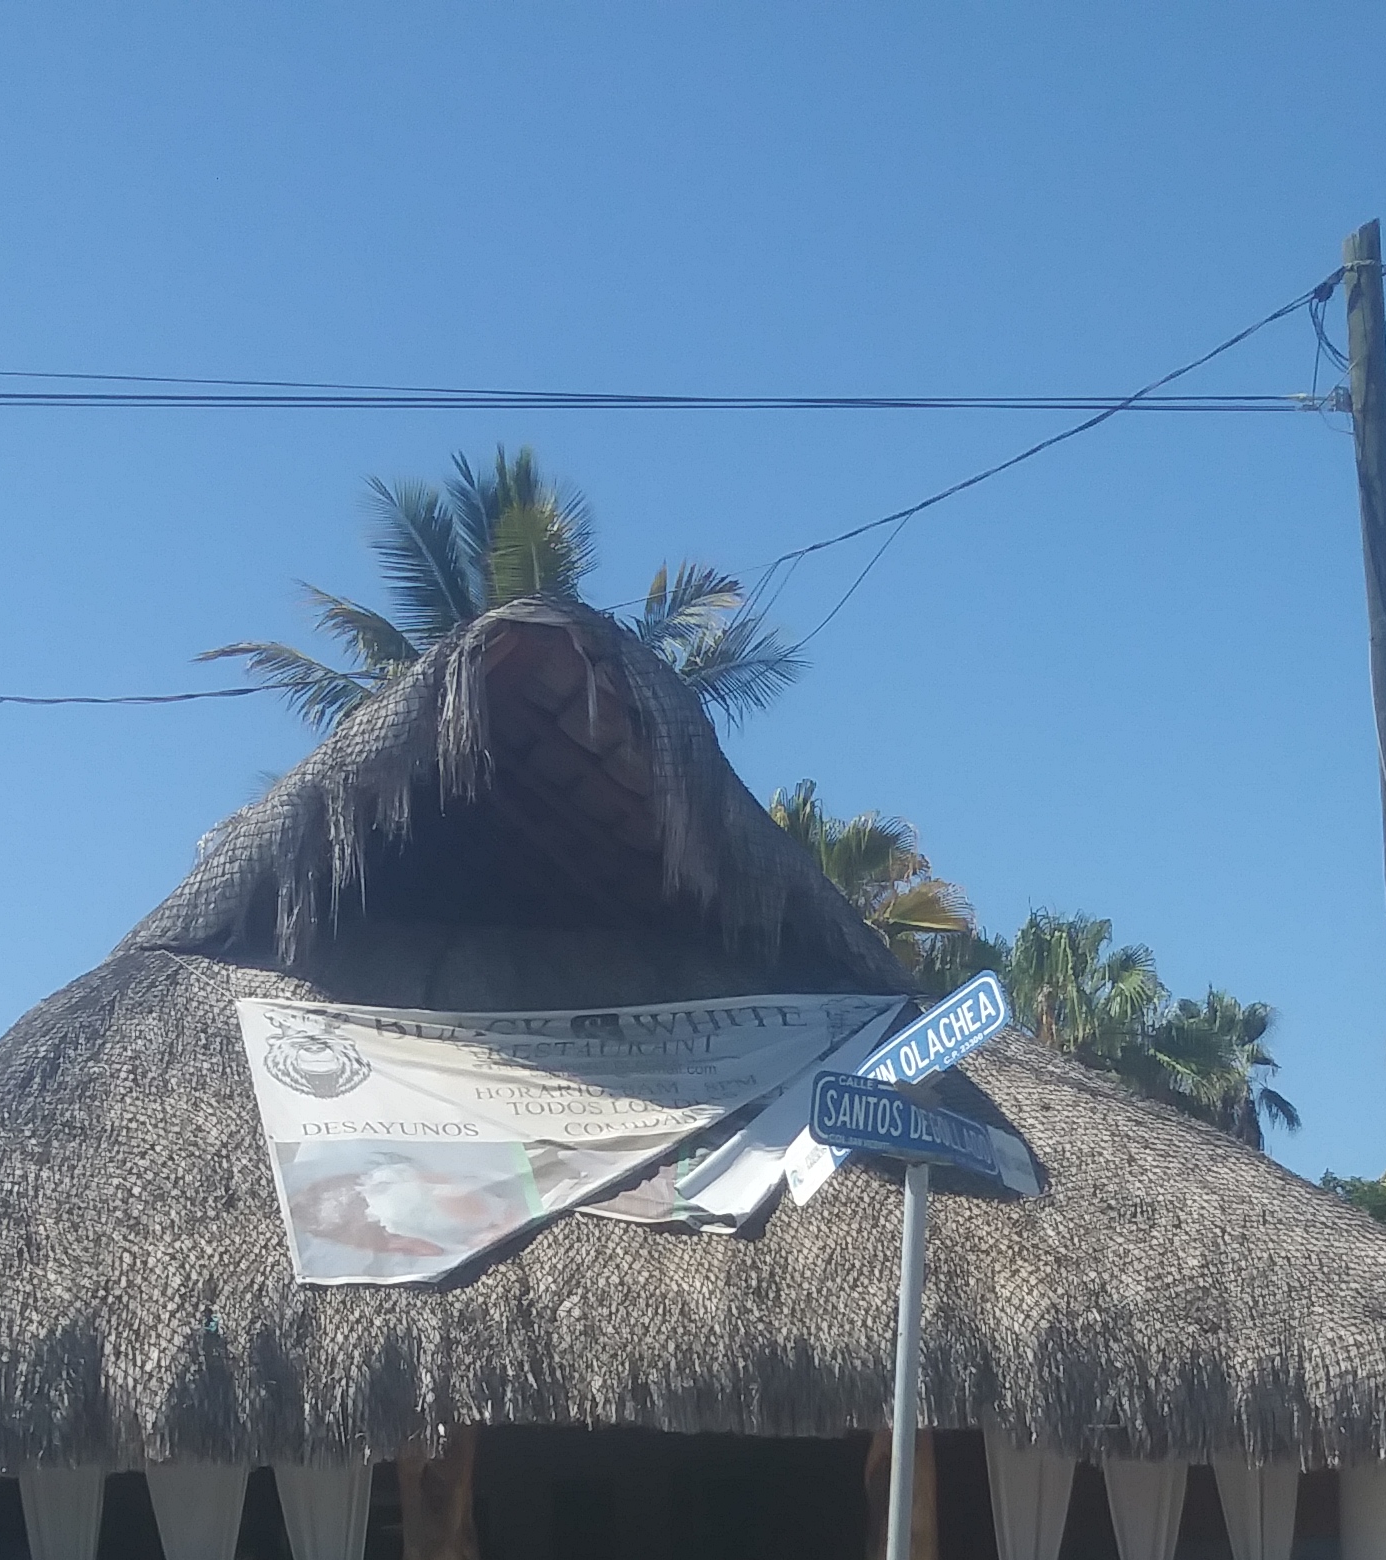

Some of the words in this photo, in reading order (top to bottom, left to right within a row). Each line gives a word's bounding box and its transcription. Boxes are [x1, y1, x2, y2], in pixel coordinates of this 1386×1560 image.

[632, 1006, 807, 1035] WHITE
[899, 991, 997, 1077] OLACHEA
[838, 1074, 879, 1090] CALLE
[506, 1101, 604, 1116] TODOS
[301, 1120, 480, 1137] DESAYUNOS
[823, 1089, 904, 1137] SANTOS
[909, 1104, 994, 1165] DEGOLLADO
